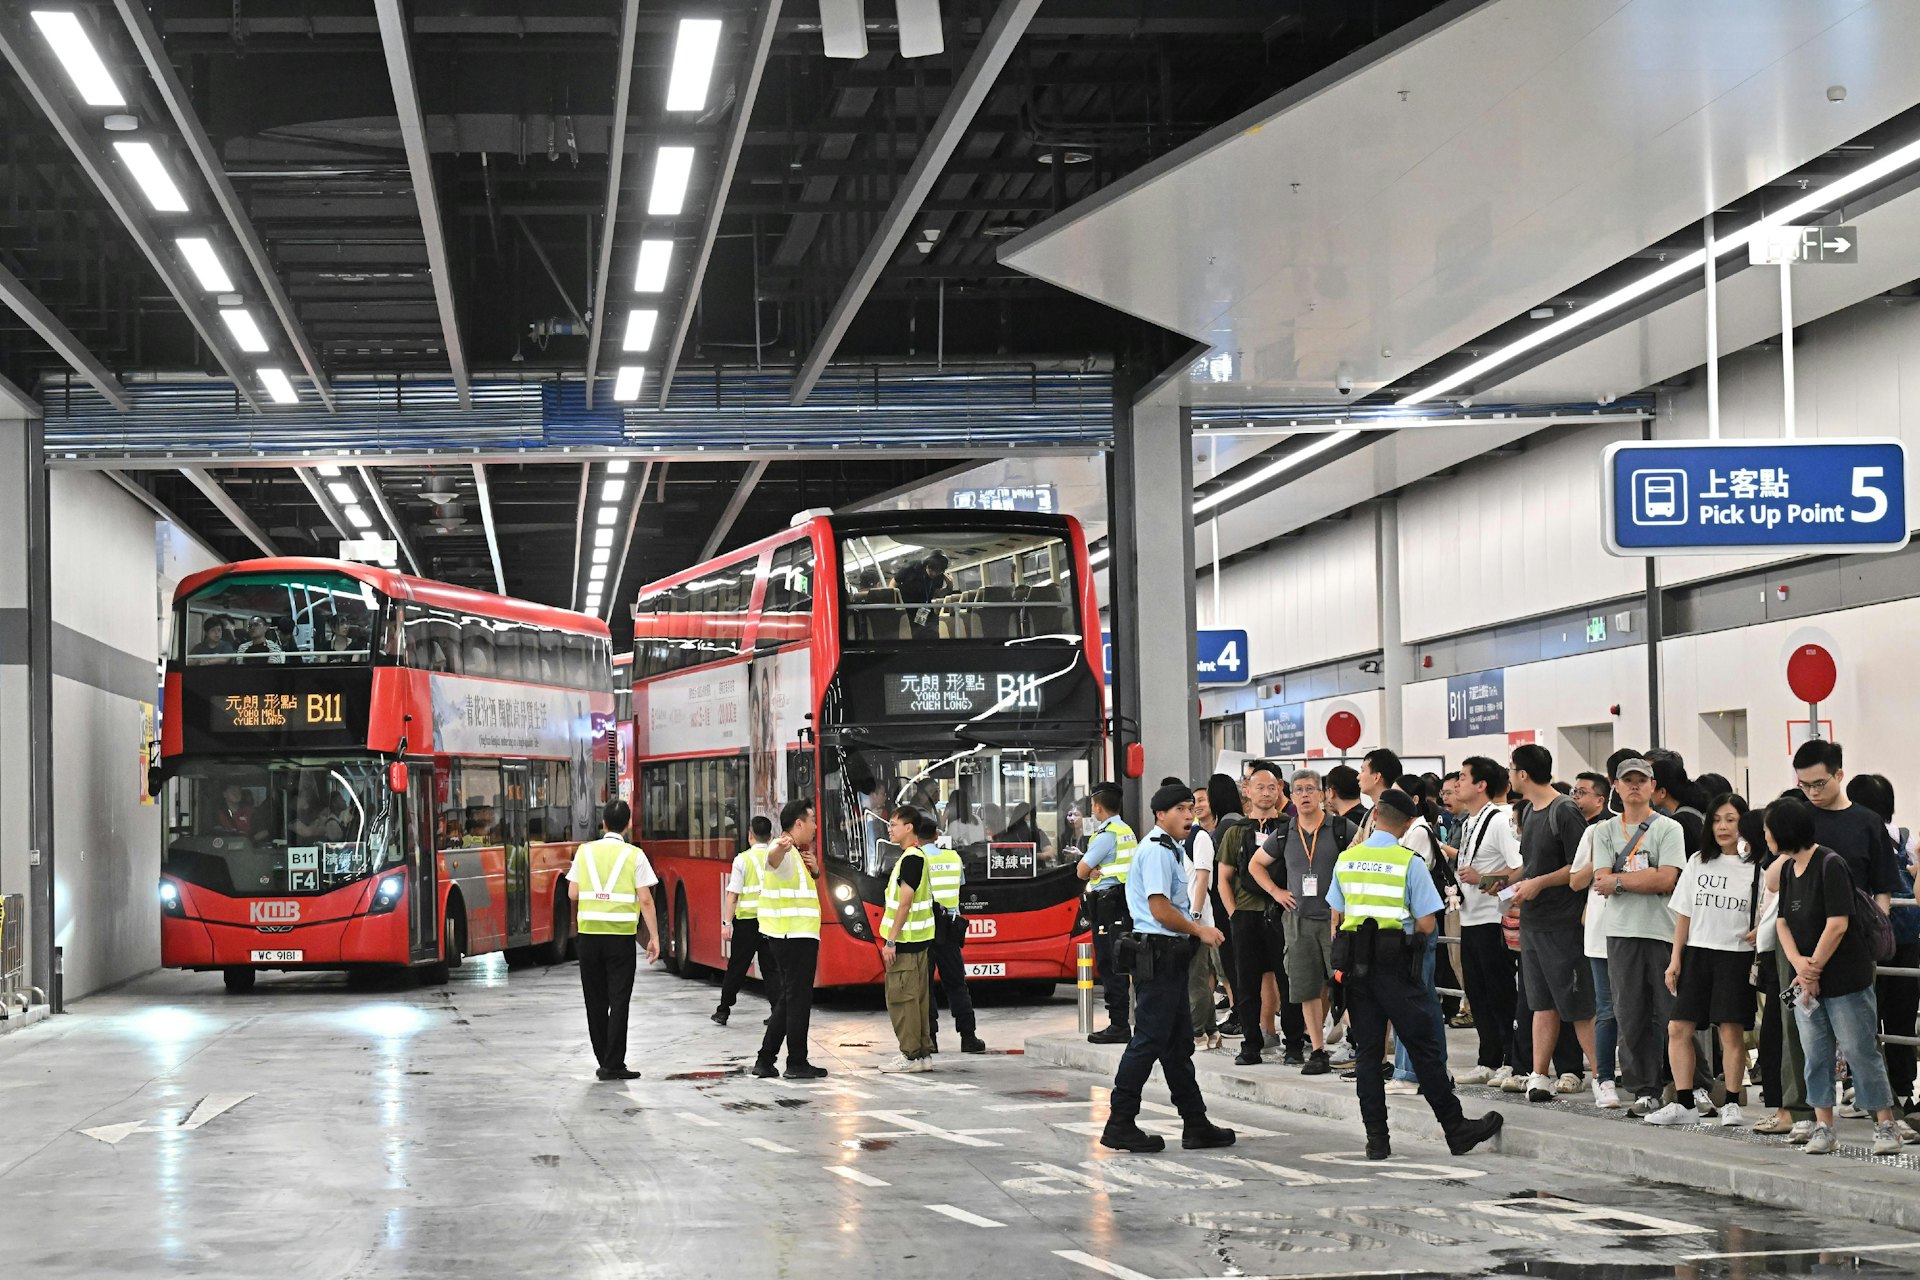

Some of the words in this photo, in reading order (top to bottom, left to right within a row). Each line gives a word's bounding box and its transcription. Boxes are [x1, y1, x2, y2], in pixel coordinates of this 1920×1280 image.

[1700, 467, 1789, 499] 上客點
[1850, 466, 1888, 523] 5
[1700, 505, 1745, 524] Pick
[1750, 505, 1781, 529] Up
[1788, 502, 1845, 523] Point
[1217, 641, 1240, 671] 4
[901, 674, 938, 692] 元朗
[945, 674, 985, 691] 形點
[996, 674, 1038, 707] B11
[225, 695, 259, 711] 元朗
[263, 694, 298, 709] 形點
[915, 691, 940, 701] YOHO
[943, 691, 968, 701] MALL
[1450, 689, 1467, 722] B11
[237, 709, 259, 718] YOHO
[262, 709, 283, 717] MALL
[307, 693, 342, 723] B11
[292, 853, 314, 864] B11
[991, 855, 1033, 870] 演練中
[1356, 861, 1383, 873] POLICE
[292, 871, 316, 890] F4
[1697, 874, 1728, 889] QUI
[1695, 890, 1749, 912] ÉTUDE
[249, 901, 301, 923] KMB
[965, 918, 997, 939] MB
[258, 951, 272, 960] WC
[276, 951, 296, 961] 9181
[972, 964, 1000, 975] 6713
[1000, 1152, 1487, 1195] STOP
[1170, 1197, 1718, 1253] BUS
